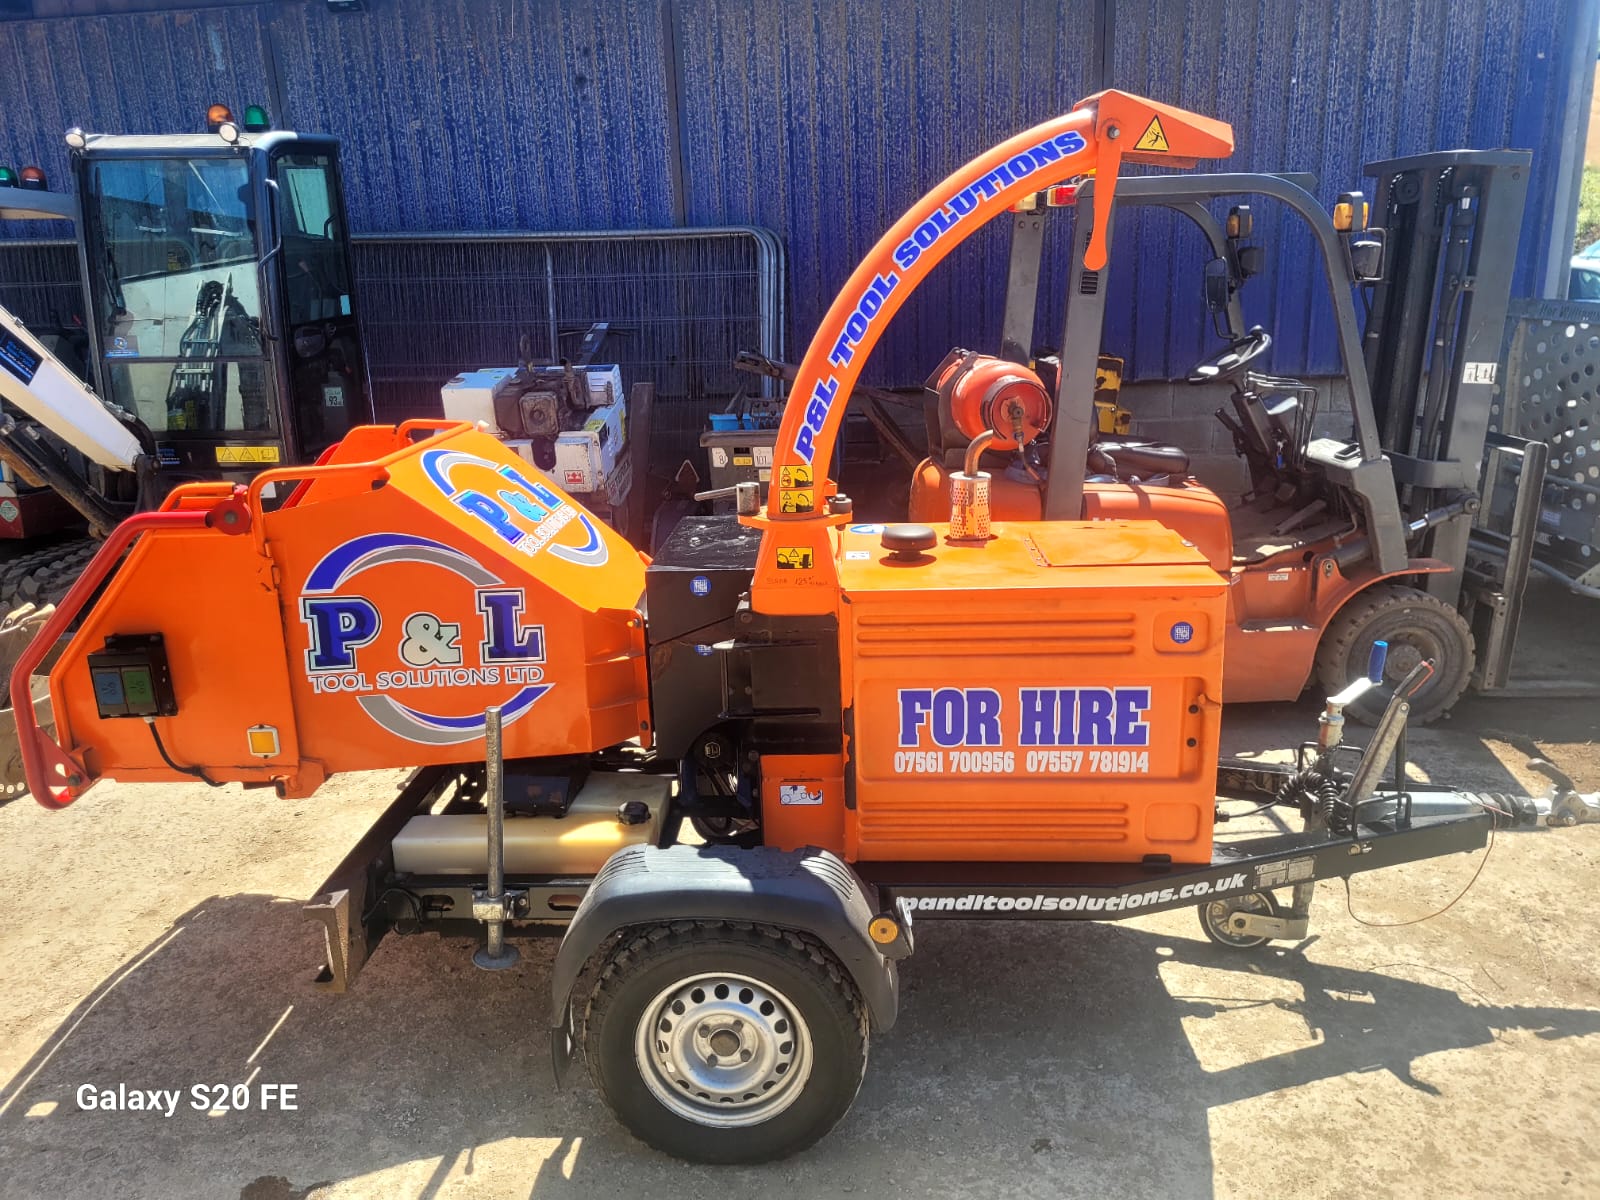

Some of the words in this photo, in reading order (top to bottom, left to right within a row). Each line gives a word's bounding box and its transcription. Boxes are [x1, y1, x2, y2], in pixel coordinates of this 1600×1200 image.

[793, 375, 840, 465] P&L
[827, 271, 900, 368] TOOL
[892, 130, 1087, 272] SOLUTIONS
[496, 464, 564, 510] L
[497, 489, 550, 522] &
[449, 490, 526, 545] P
[300, 596, 381, 673] P
[399, 612, 462, 667] &
[475, 588, 546, 665] L
[308, 674, 372, 693] TOOL
[377, 668, 499, 688] SOLUTIONS
[505, 666, 544, 684] LTD
[898, 687, 1002, 747] FOR
[1018, 686, 1151, 747] HIRE
[894, 751, 943, 773] 07561
[949, 751, 1015, 773] 700956
[1026, 751, 1083, 773] 07557
[1089, 751, 1149, 773] 781914
